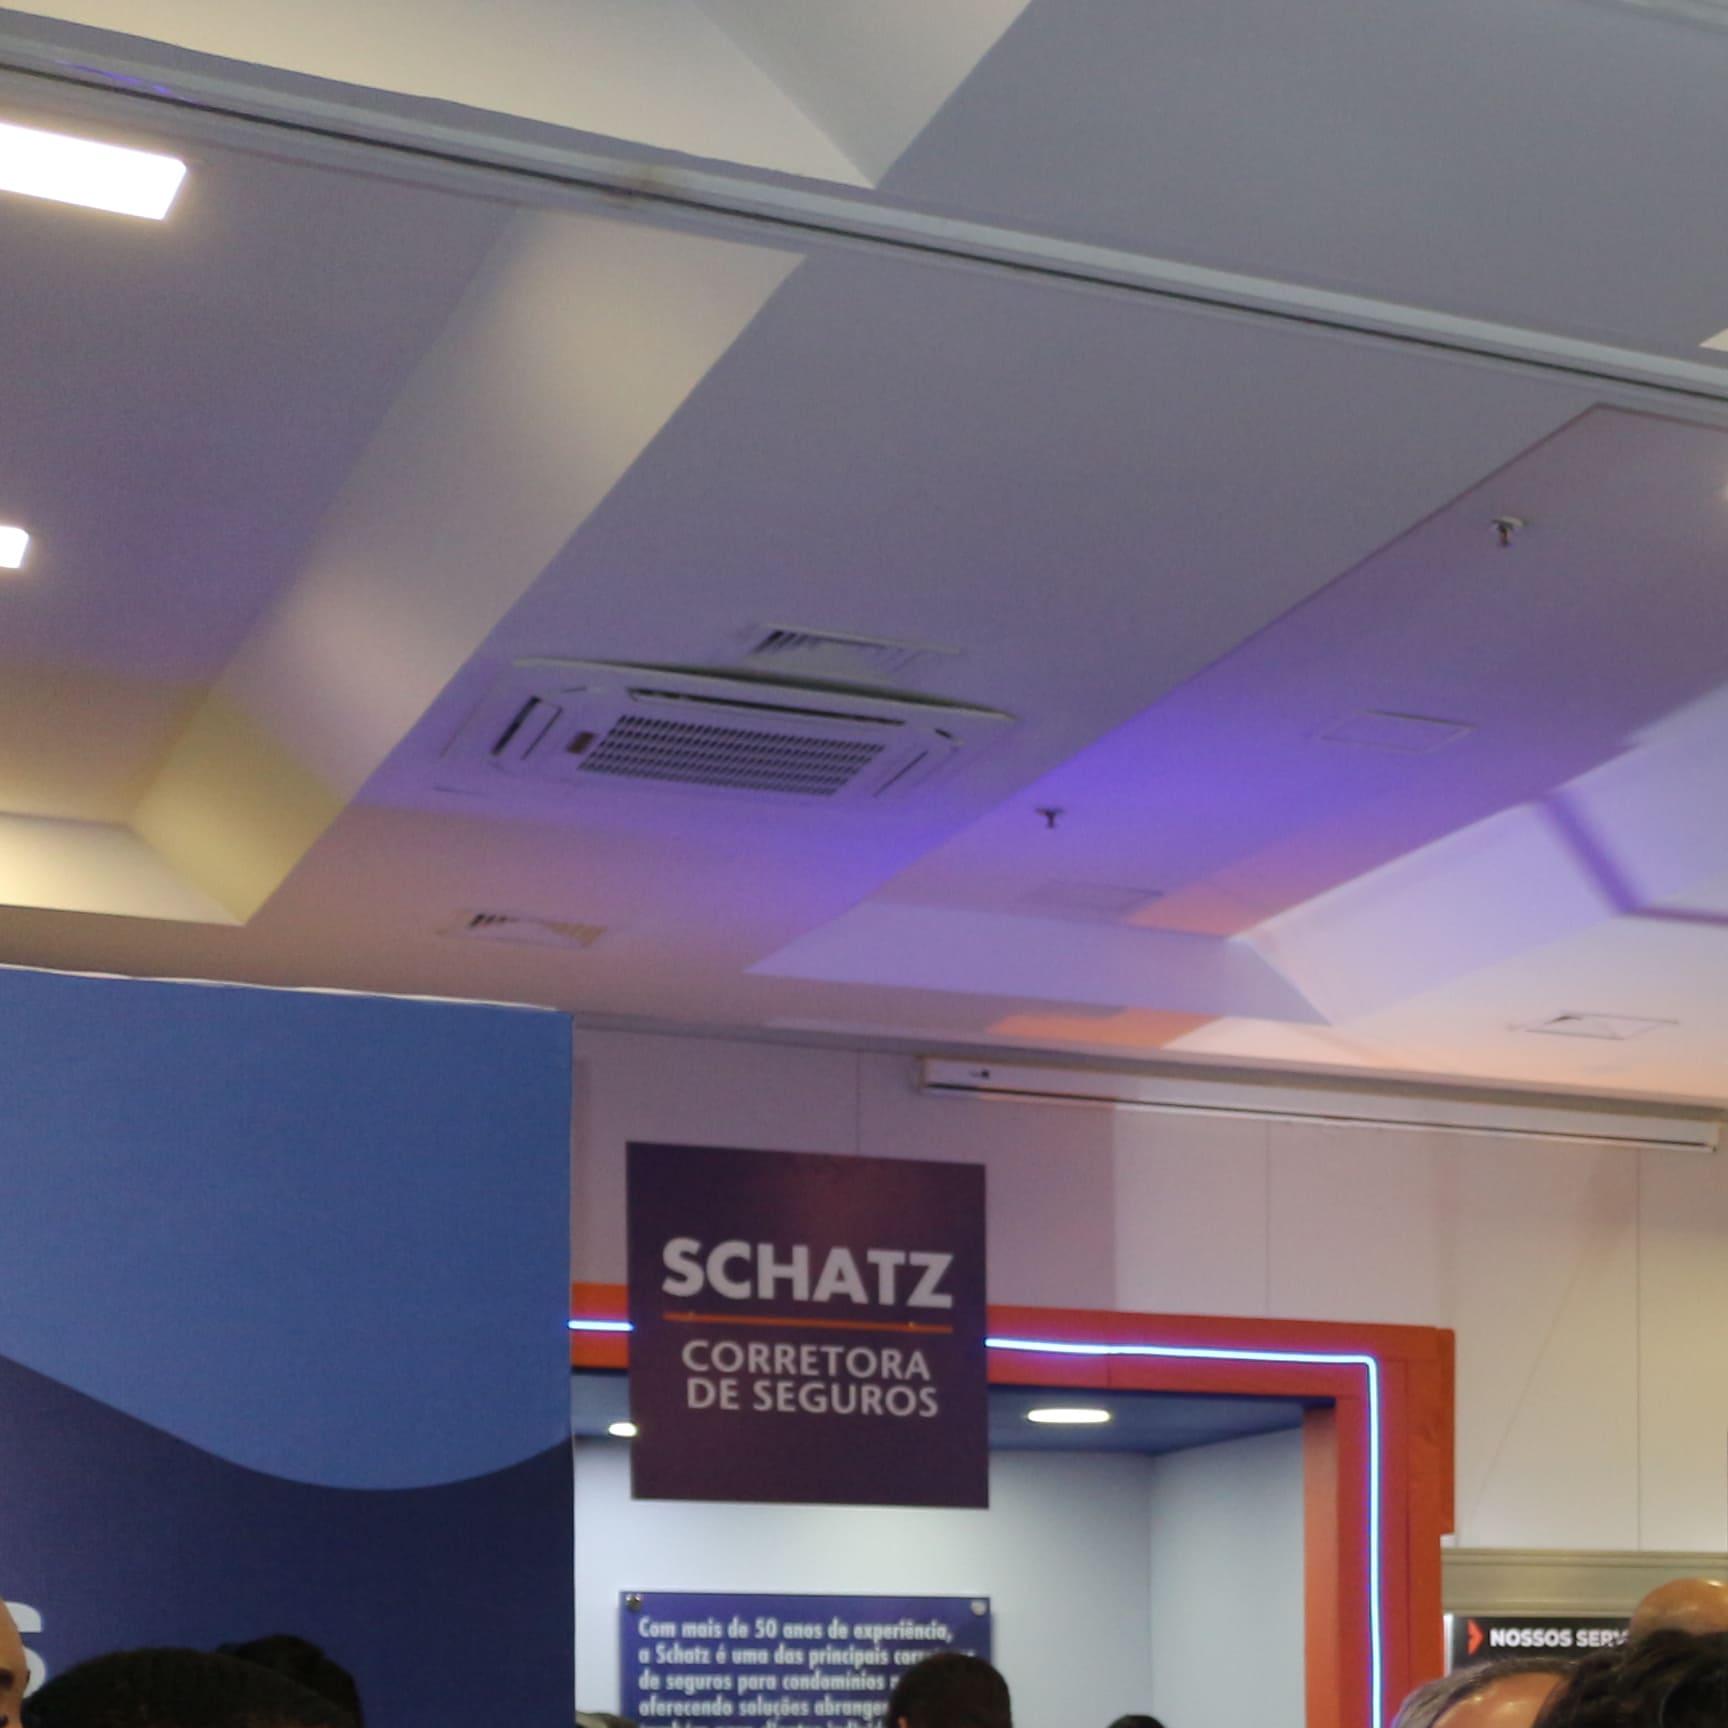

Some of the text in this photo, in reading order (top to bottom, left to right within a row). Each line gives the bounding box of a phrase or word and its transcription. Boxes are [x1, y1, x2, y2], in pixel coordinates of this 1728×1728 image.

[662, 1237, 953, 1309] SCHATZ
[681, 1340, 931, 1380] CORRETORA
[687, 1378, 938, 1418] DE SEGUROS
[638, 1616, 952, 1643] Com mais de 50 anos de experiência,
[1490, 1628, 1572, 1647] NOSSOS
[638, 1648, 650, 1663] a
[655, 1643, 709, 1664] Schatz
[715, 1643, 726, 1664] é
[732, 1649, 768, 1665] uma
[774, 1643, 803, 1665] das
[808, 1643, 889, 1670] principais
[638, 1670, 661, 1691] de
[665, 1674, 732, 1696] seguros
[737, 1674, 777, 1696] para
[782, 1669, 885, 1691] condomínios
[638, 1696, 733, 1718] oferecendo
[738, 1695, 810, 1720] soluções
